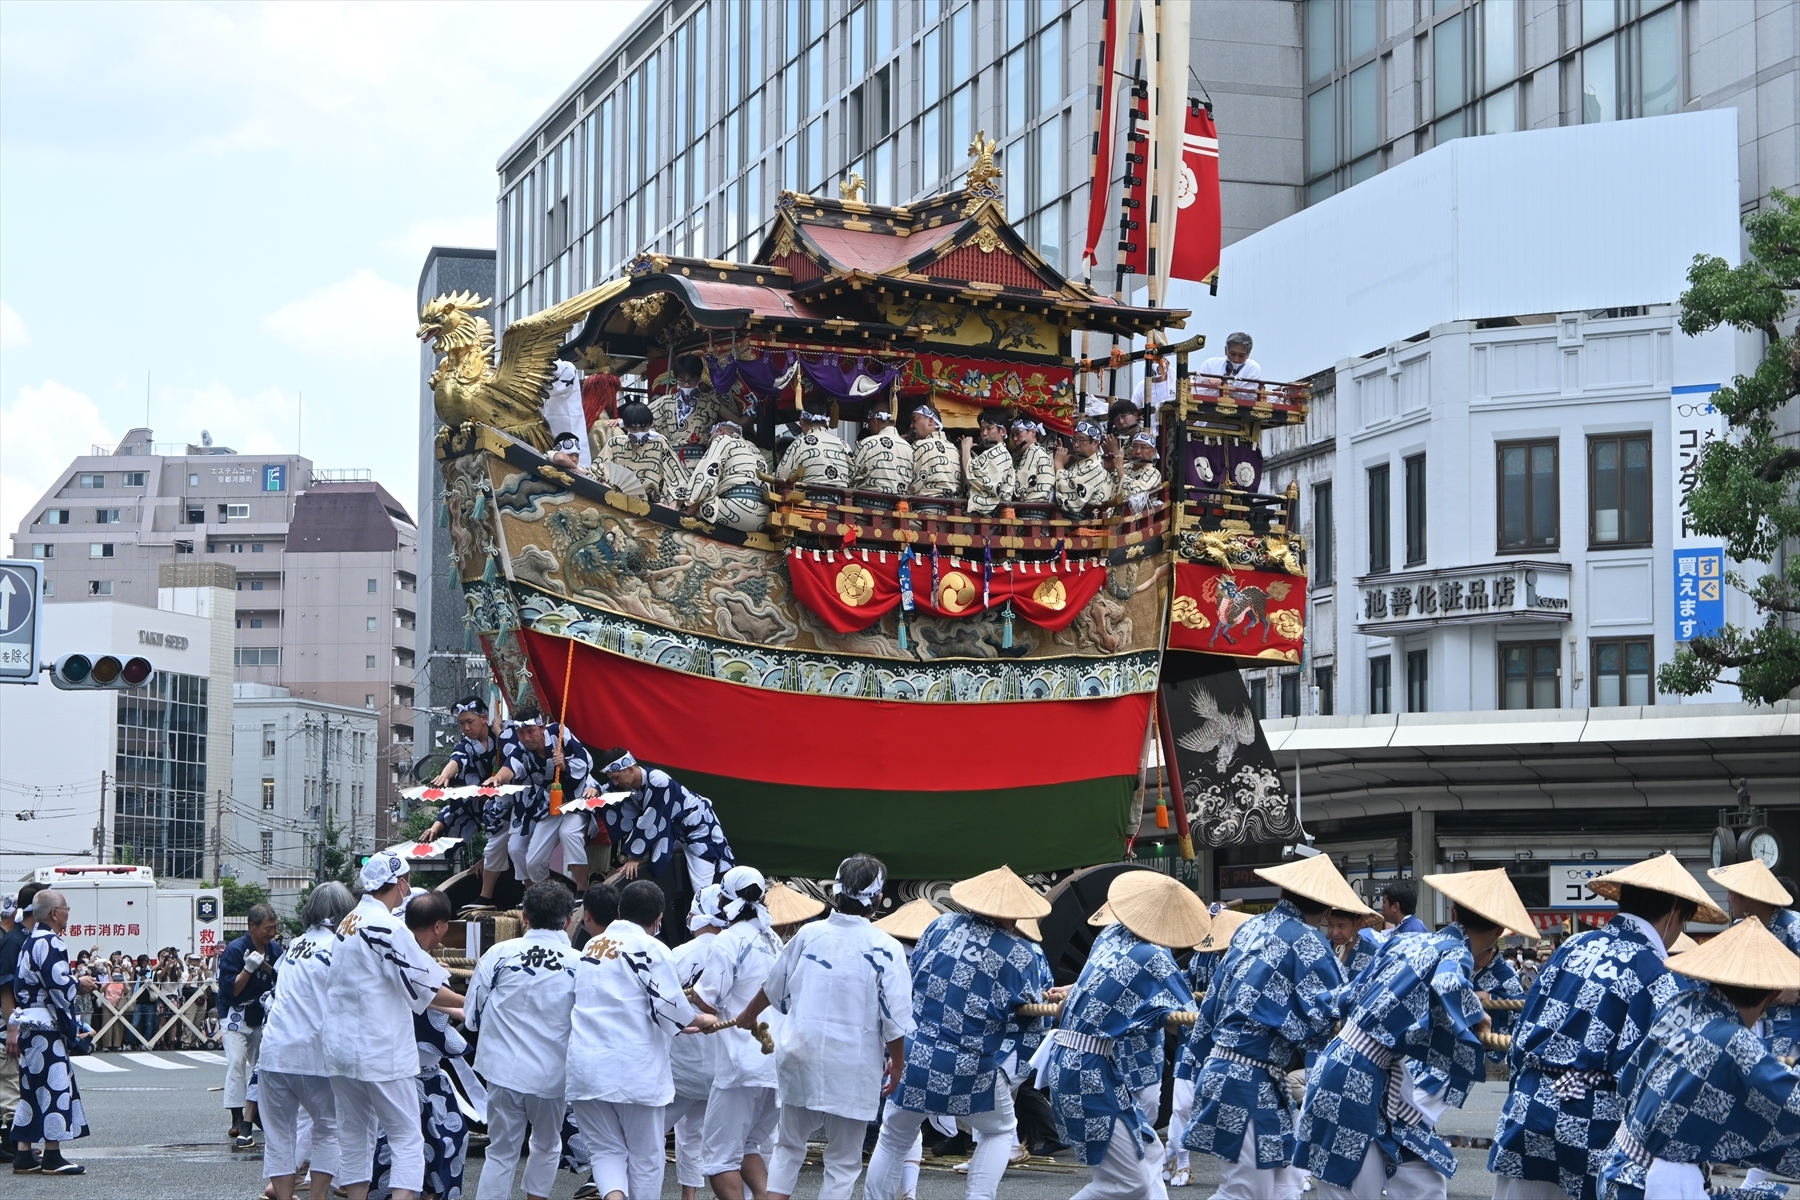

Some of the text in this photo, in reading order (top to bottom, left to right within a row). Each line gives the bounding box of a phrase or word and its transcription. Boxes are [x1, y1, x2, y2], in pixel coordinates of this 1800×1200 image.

[210, 467, 258, 475] エステムコート
[217, 475, 253, 483] 京都河原町
[1700, 558, 1717, 599] すぐ
[1364, 576, 1516, 618] 池善化粧品店
[1678, 557, 1697, 638] 買えます
[1566, 885, 1607, 901] コン
